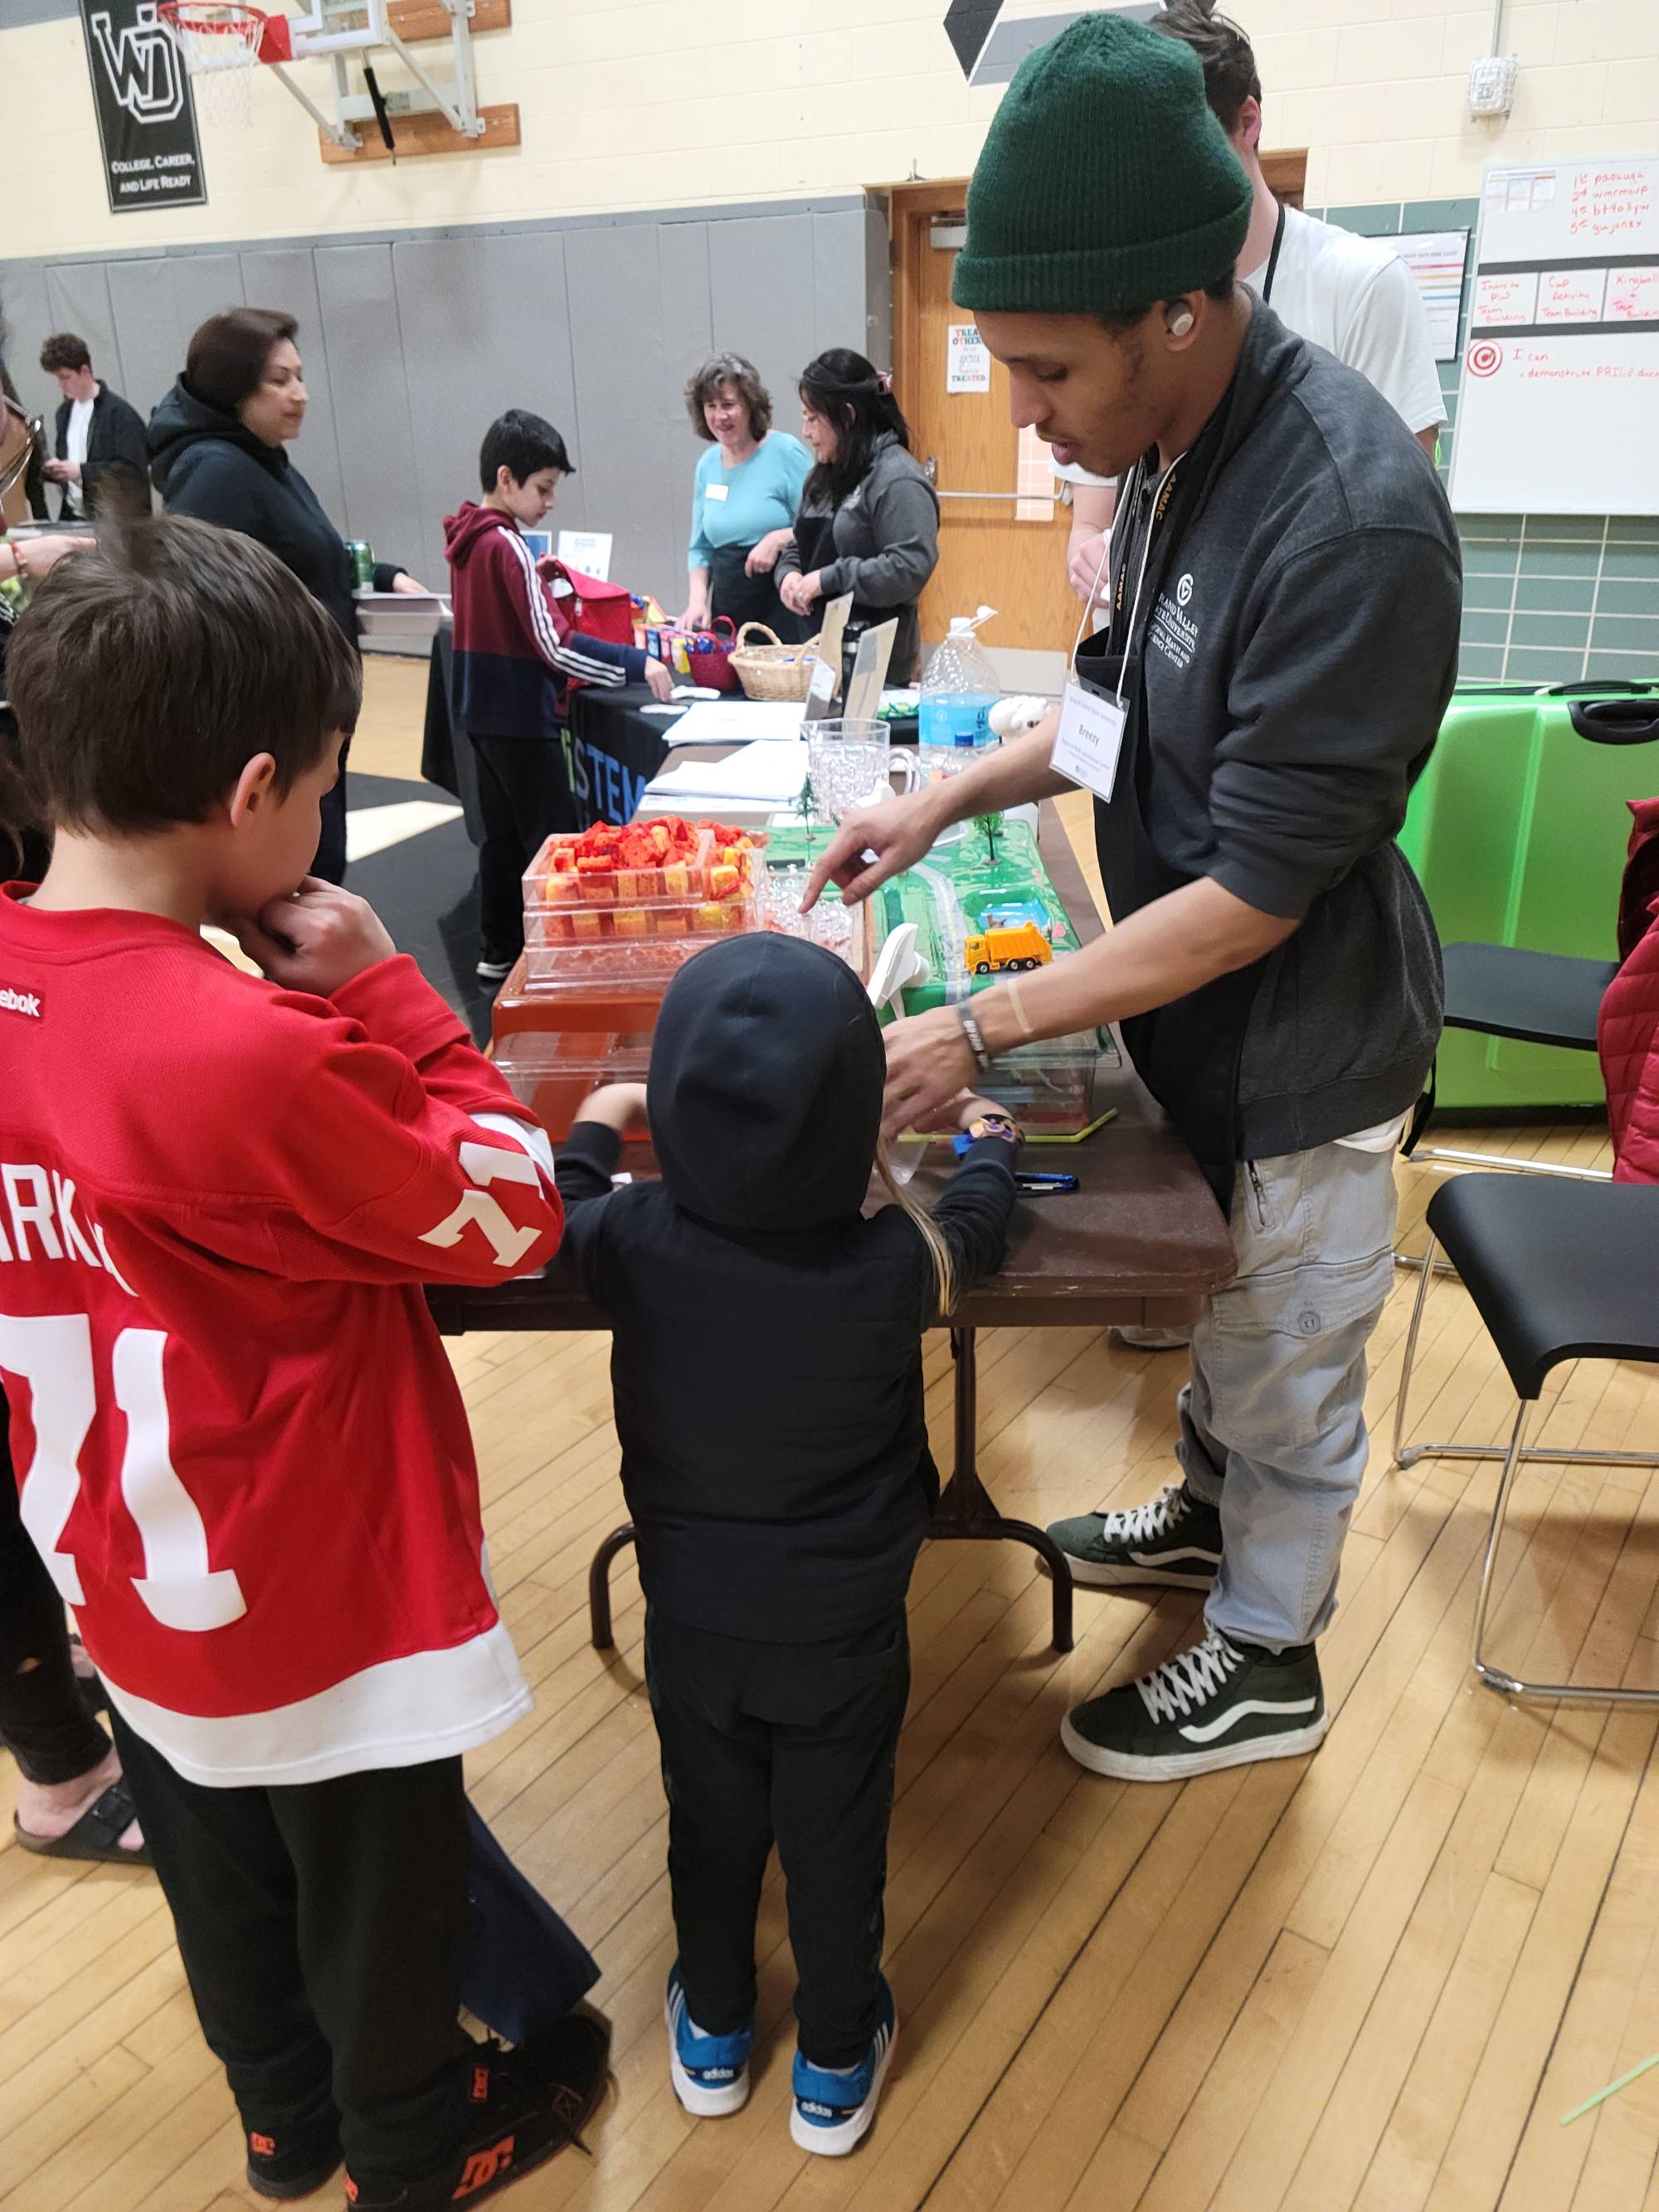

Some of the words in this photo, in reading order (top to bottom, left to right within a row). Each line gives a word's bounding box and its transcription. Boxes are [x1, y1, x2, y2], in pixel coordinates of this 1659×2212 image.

[139, 178, 159, 192] LIFE
[160, 175, 192, 189] READY
[952, 336, 983, 346] OTHER
[956, 329, 979, 337] TREA
[1158, 592, 1177, 616] RAND
[1078, 724, 1101, 747] Breezy
[0, 1313, 248, 1631] 71
[702, 2068, 734, 2079] adidas
[800, 2101, 833, 2117] adidas
